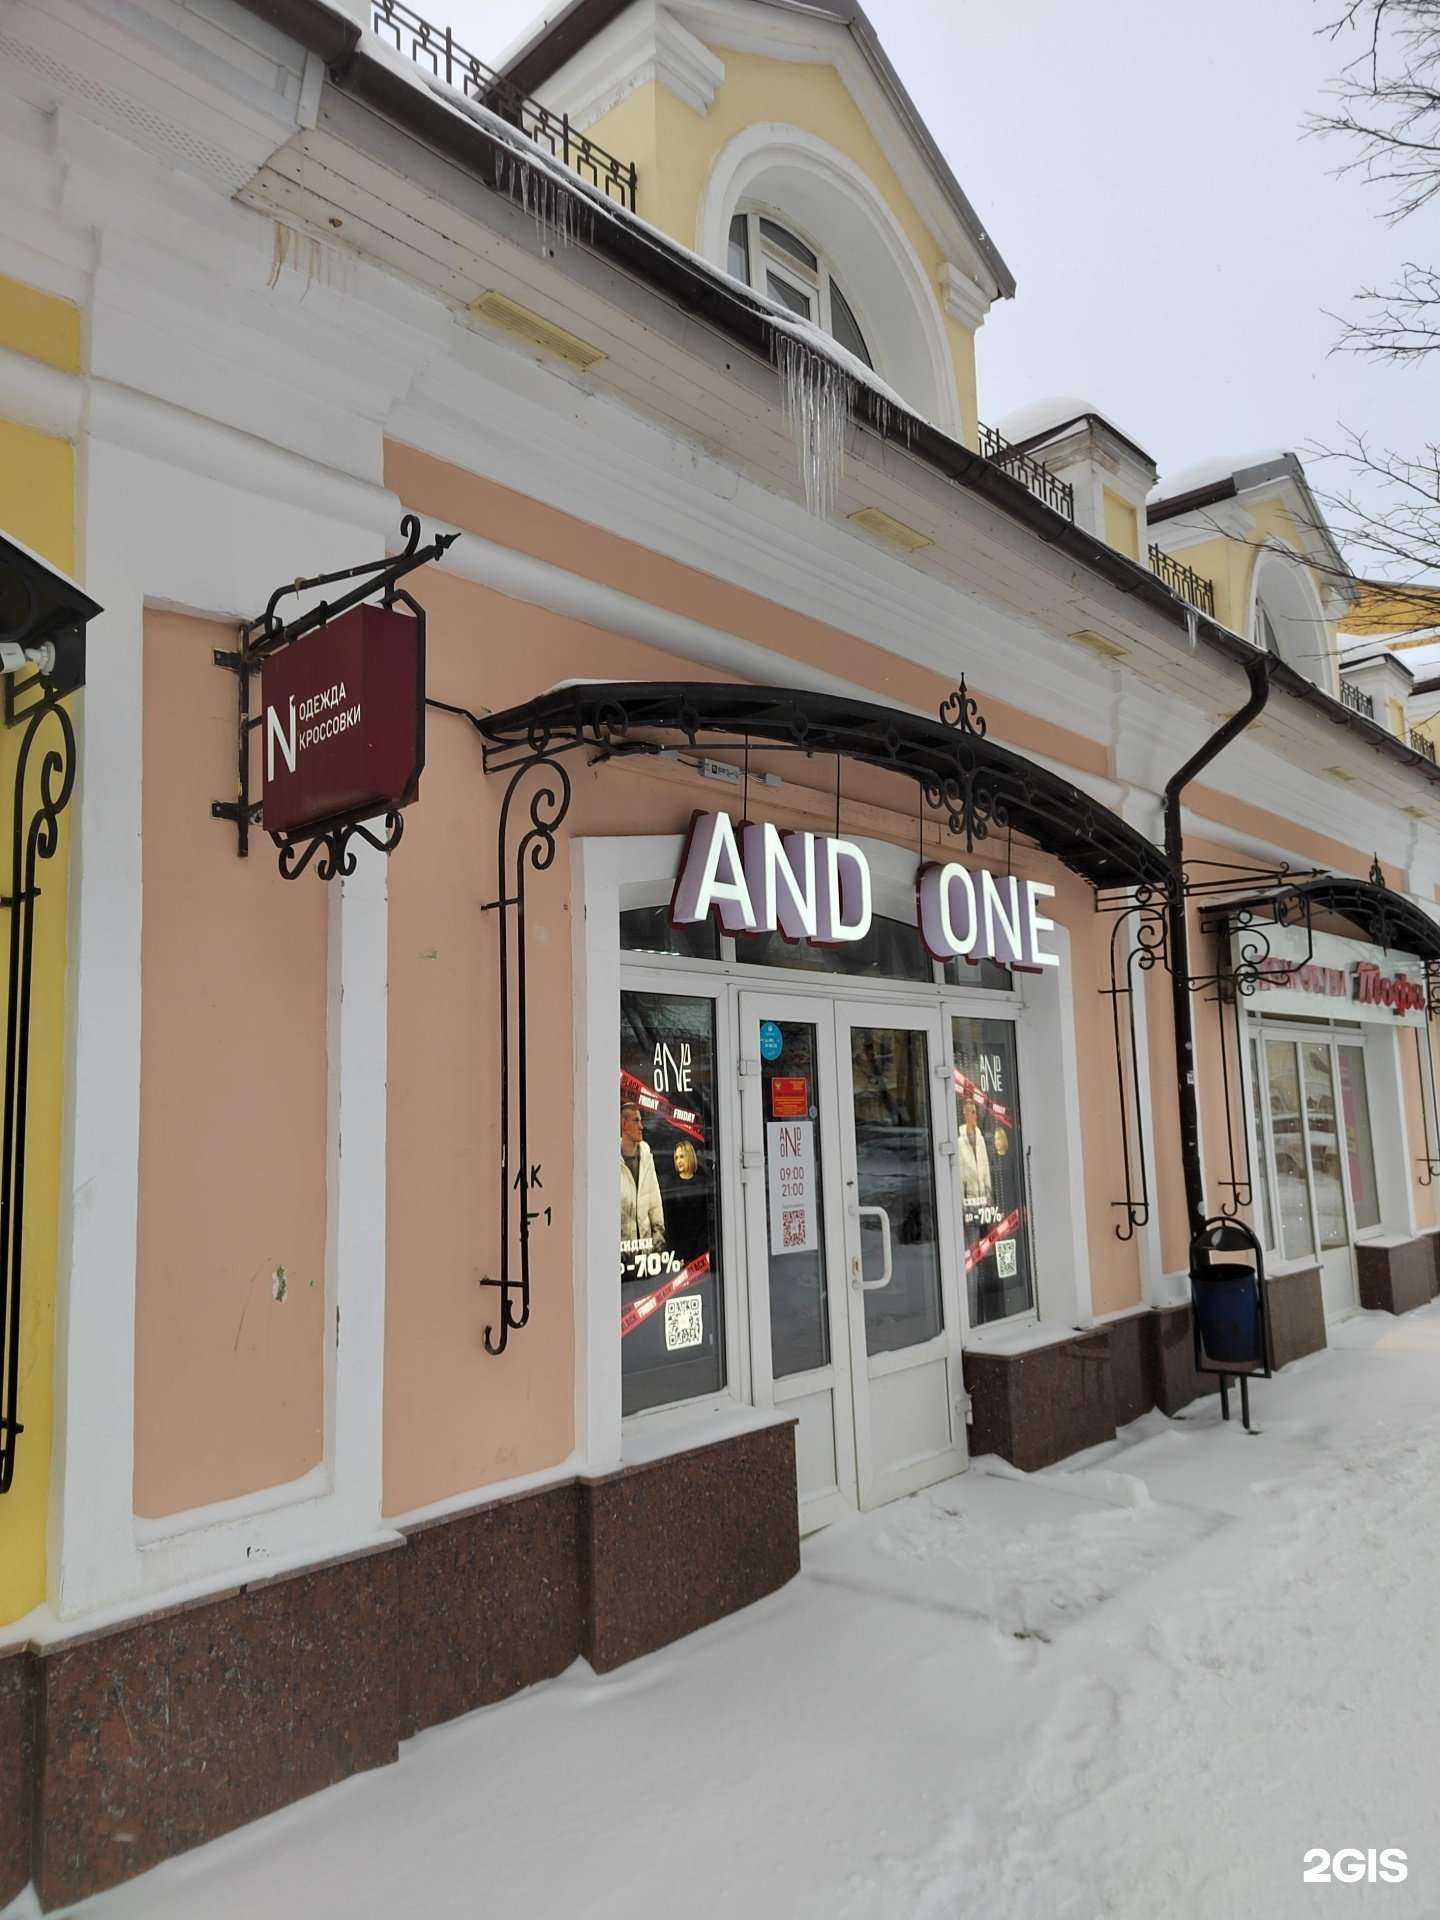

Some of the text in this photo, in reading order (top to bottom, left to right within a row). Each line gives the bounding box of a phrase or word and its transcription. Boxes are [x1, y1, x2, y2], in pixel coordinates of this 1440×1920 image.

[299, 682, 347, 721] ОДЕЖДА
[267, 695, 296, 782] N
[299, 704, 361, 751] КРОССОВКИ
[690, 811, 1060, 968] AND ONE
[638, 1094, 659, 1111] FRIDAY
[673, 1108, 696, 1124] FRIDAY
[780, 1167, 804, 1181] 09:00
[782, 1183, 804, 1197] 21:00
